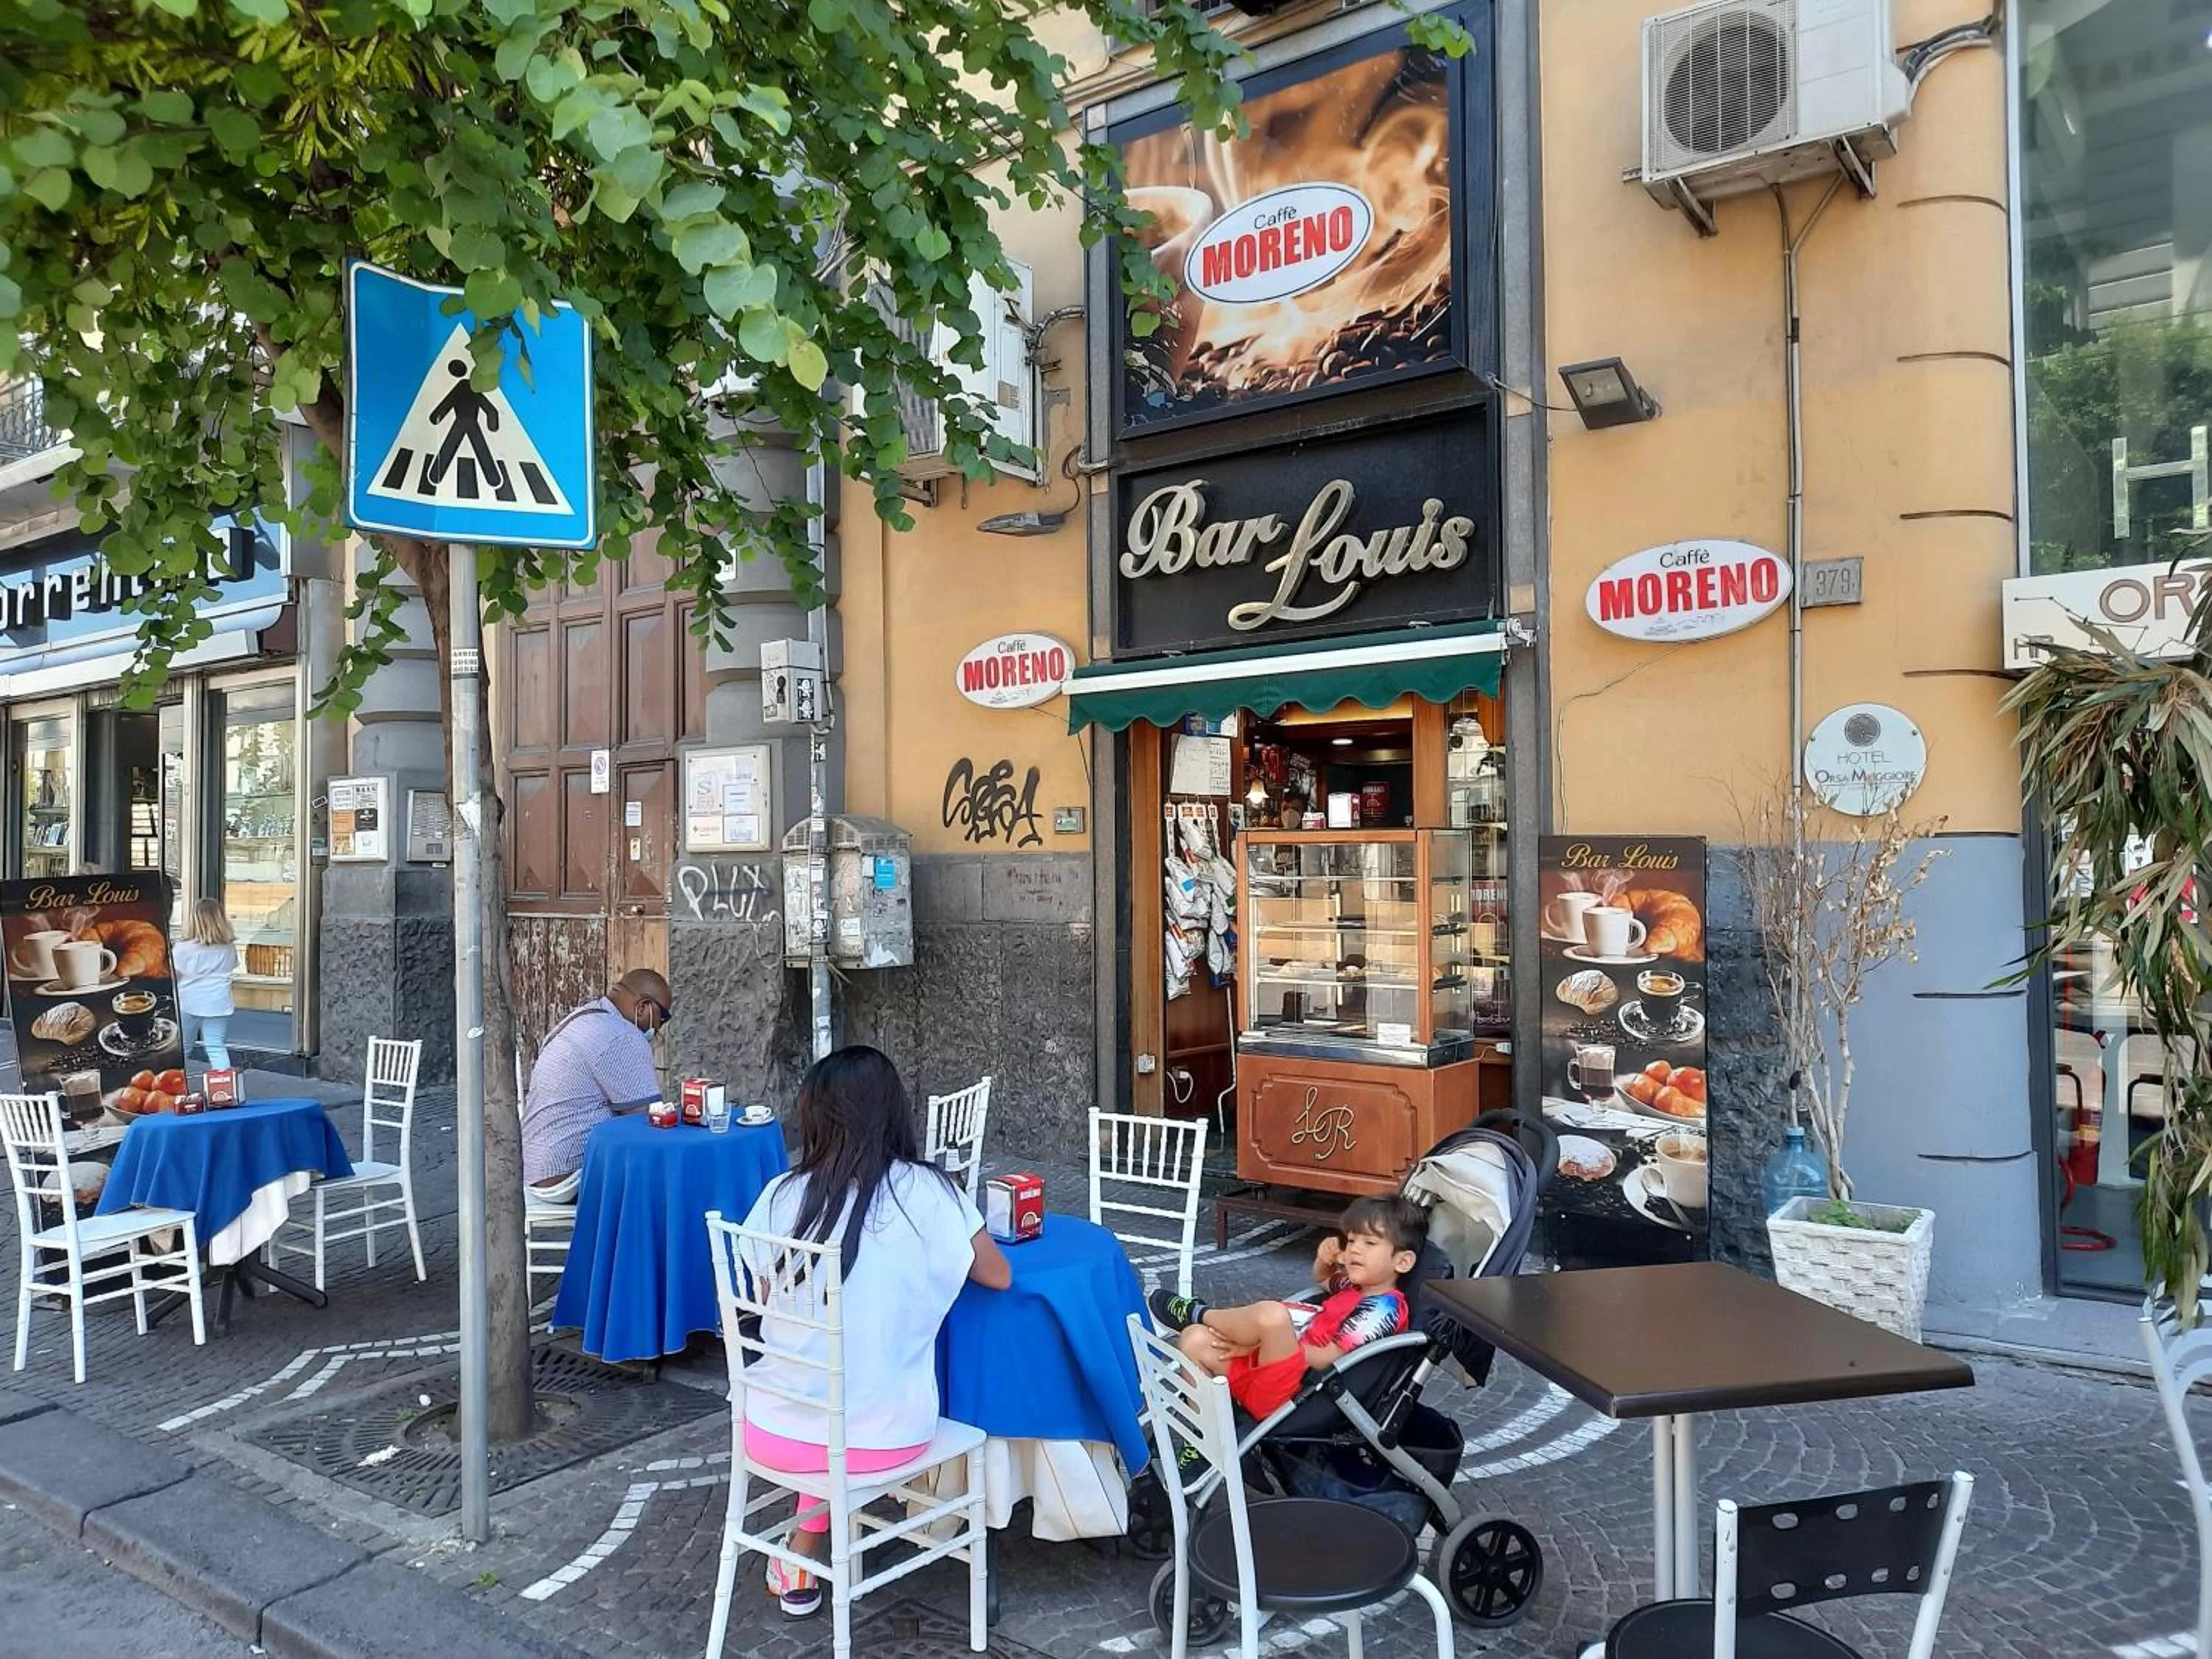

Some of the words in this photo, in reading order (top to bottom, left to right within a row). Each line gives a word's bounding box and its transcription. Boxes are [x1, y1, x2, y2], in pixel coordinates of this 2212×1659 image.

[1253, 206, 1298, 230] Caffè
[1202, 206, 1353, 288] MORENO
[1119, 479, 1291, 580] Bar
[1228, 479, 1475, 630] Louis
[1659, 548, 1711, 568] Caffè
[1599, 557, 1779, 622] MORENO
[2099, 571, 2212, 623] OR
[963, 647, 1065, 692] MORENO
[1837, 750, 1893, 765] HOTEL
[1560, 843, 1611, 869] Bar
[1617, 843, 1680, 869] Louis
[24, 885, 76, 909] Bar
[83, 881, 141, 905] Louis
